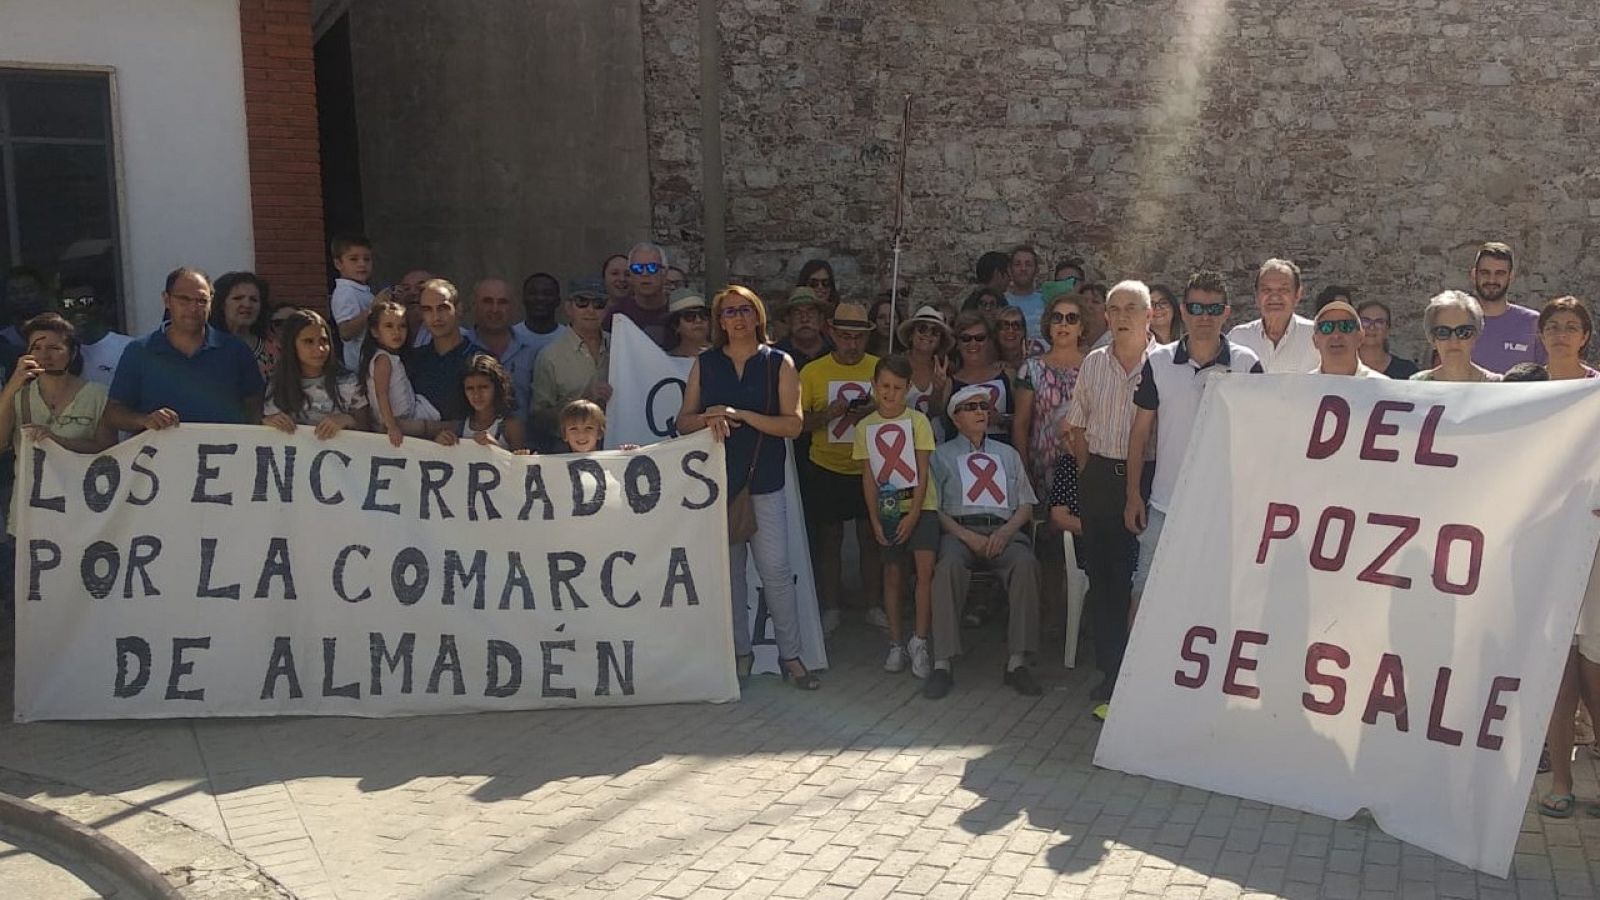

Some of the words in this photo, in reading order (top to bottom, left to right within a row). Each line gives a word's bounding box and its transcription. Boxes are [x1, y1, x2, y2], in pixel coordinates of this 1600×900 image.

[1305, 394, 1459, 468] DEL
[29, 446, 160, 513] LOS
[191, 443, 720, 521] ENCERRADOS
[28, 535, 162, 601] POR
[196, 537, 298, 601] LA
[332, 545, 701, 611] COMARCA
[1255, 502, 1484, 596] POZO
[114, 636, 212, 700] DE
[260, 624, 635, 700] ALMADÉN
[1173, 625, 1270, 699] SE
[1301, 641, 1522, 751] SALE
